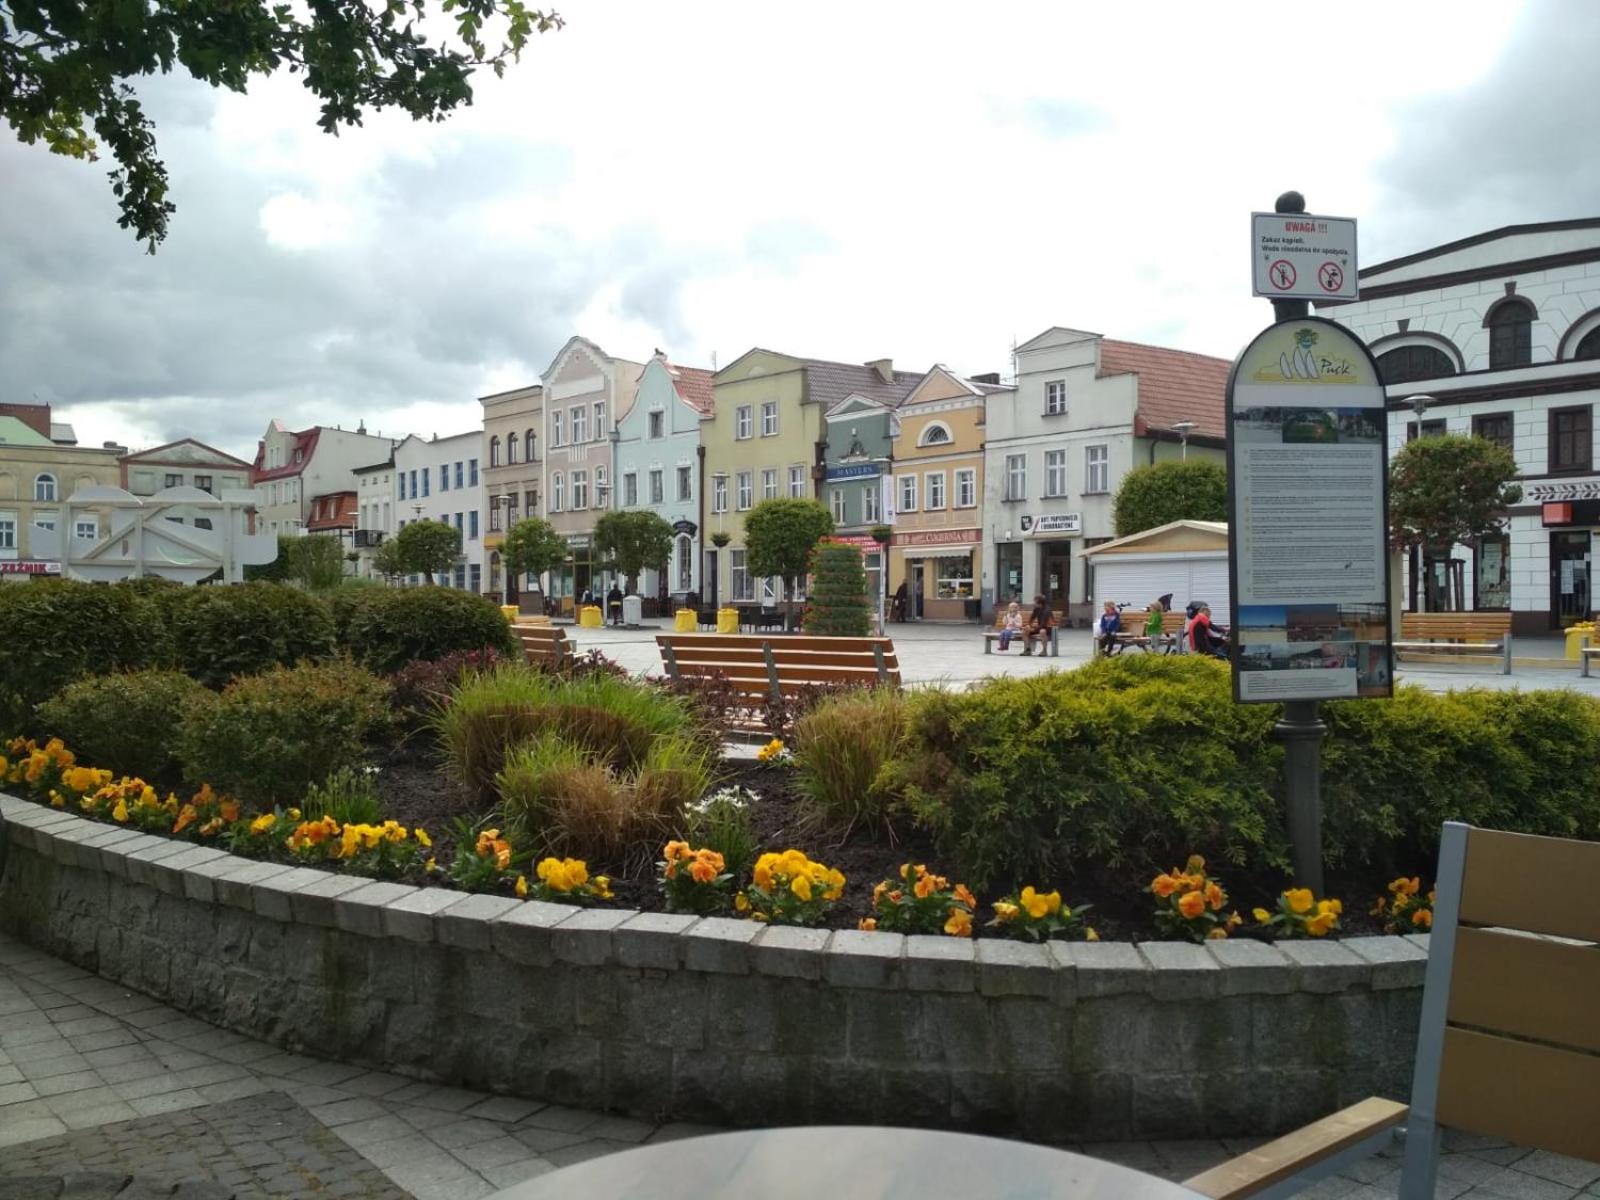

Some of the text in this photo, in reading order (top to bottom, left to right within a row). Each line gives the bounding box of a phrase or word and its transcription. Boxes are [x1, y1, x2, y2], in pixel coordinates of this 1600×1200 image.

[1285, 221, 1328, 233] UWAGA !!!
[1321, 358, 1350, 374] Puck
[838, 466, 872, 476] MASTERS
